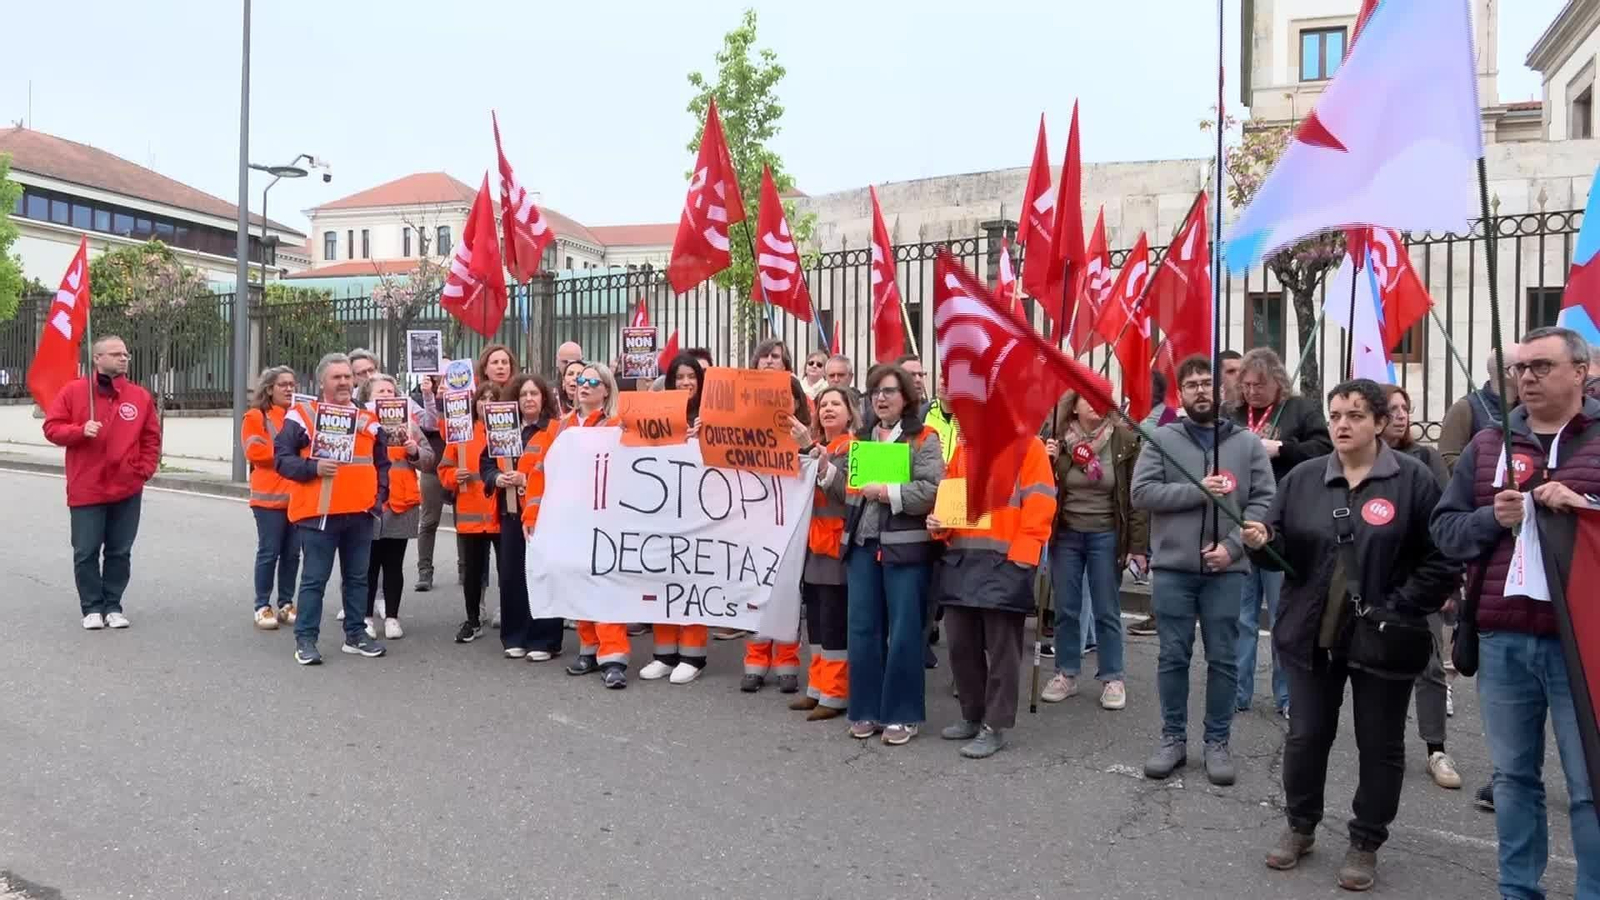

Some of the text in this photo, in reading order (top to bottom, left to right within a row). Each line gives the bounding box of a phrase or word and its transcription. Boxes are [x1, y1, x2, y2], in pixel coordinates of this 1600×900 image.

[626, 336, 653, 348] NON
[379, 408, 404, 418] NON
[446, 399, 468, 413] NON
[319, 413, 352, 429] NON
[487, 412, 514, 425] NON
[637, 417, 672, 439] NON
[705, 424, 777, 448] QUEREMOS
[725, 449, 794, 471] CONCILIAR
